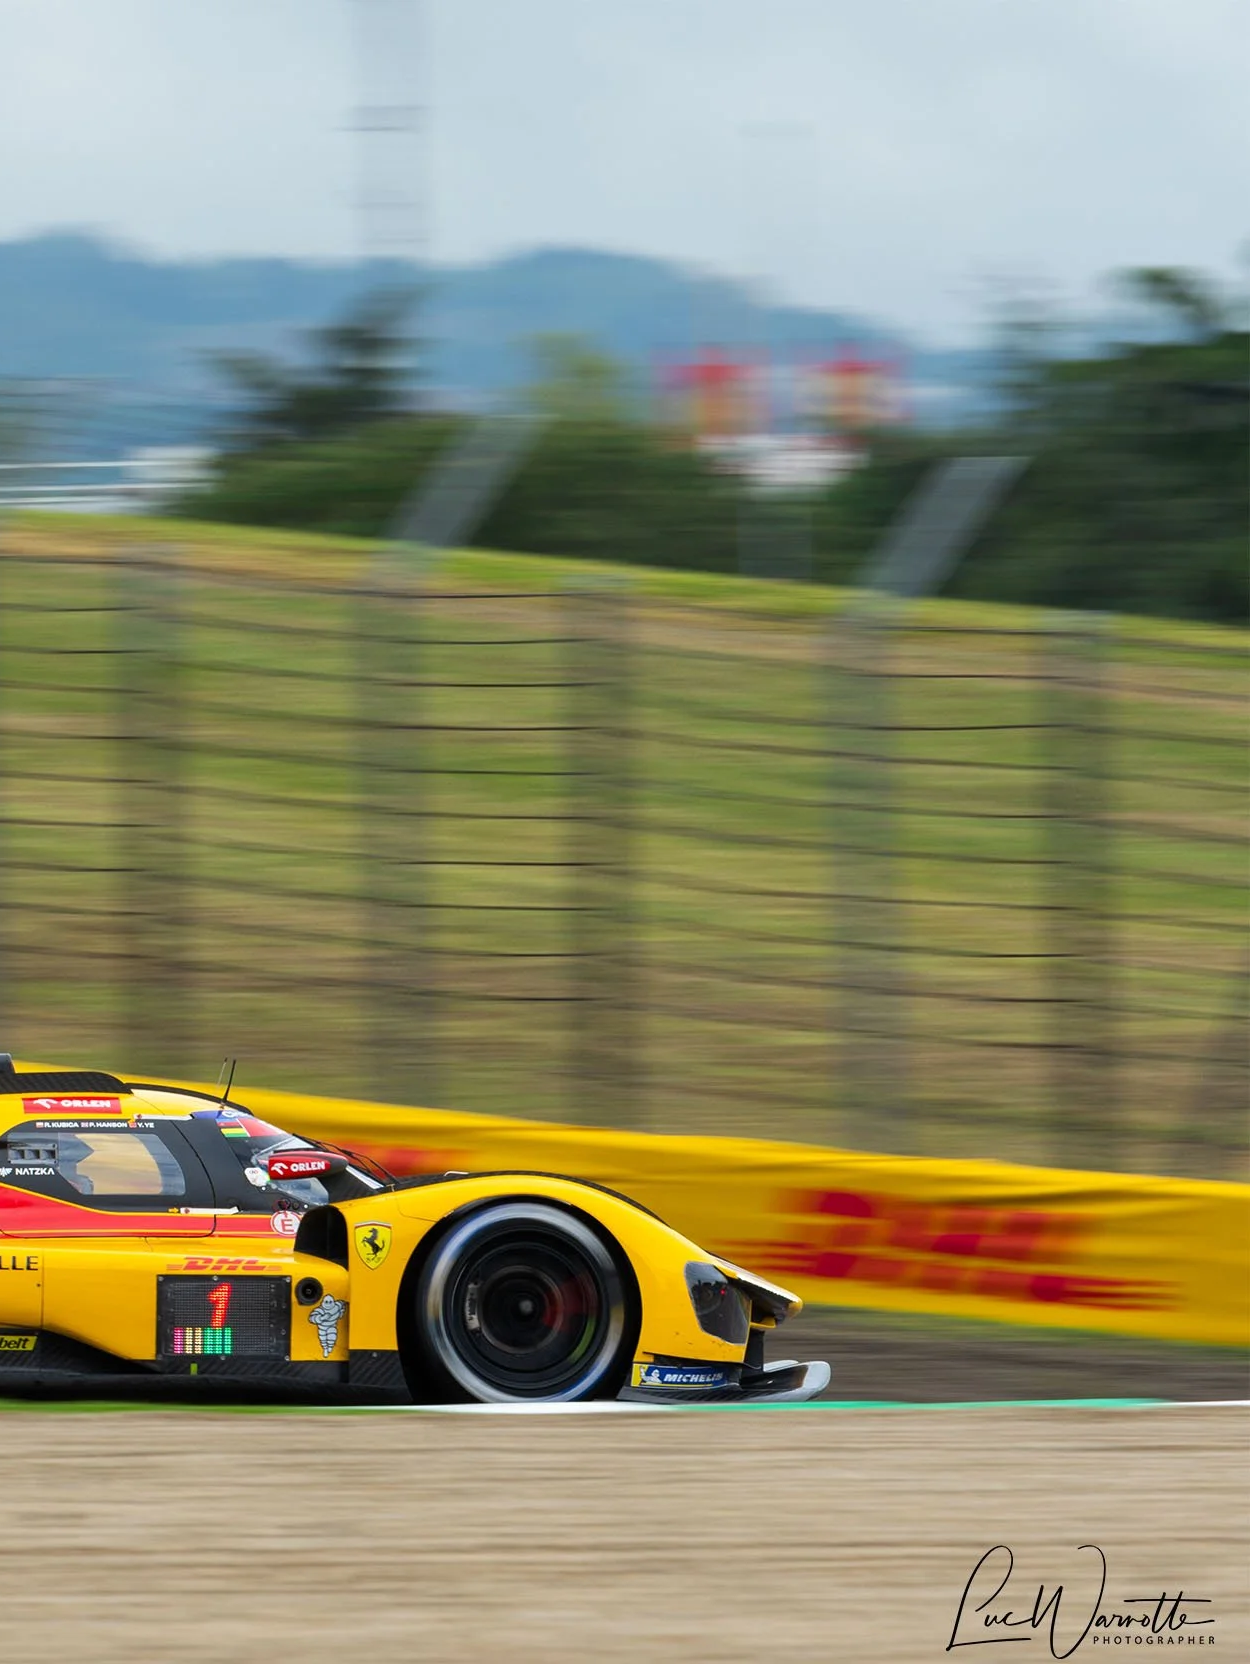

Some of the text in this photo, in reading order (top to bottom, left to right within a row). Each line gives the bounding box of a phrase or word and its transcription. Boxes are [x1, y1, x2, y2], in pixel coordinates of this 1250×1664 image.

[61, 1099, 111, 1108] ORLEN
[14, 1167, 55, 1176] NATZKA
[290, 1161, 326, 1173] ORLEN
[281, 1218, 294, 1232] E
[182, 1256, 268, 1271] DHL
[207, 1282, 232, 1328] 1
[663, 1373, 724, 1383] MICHELIN
